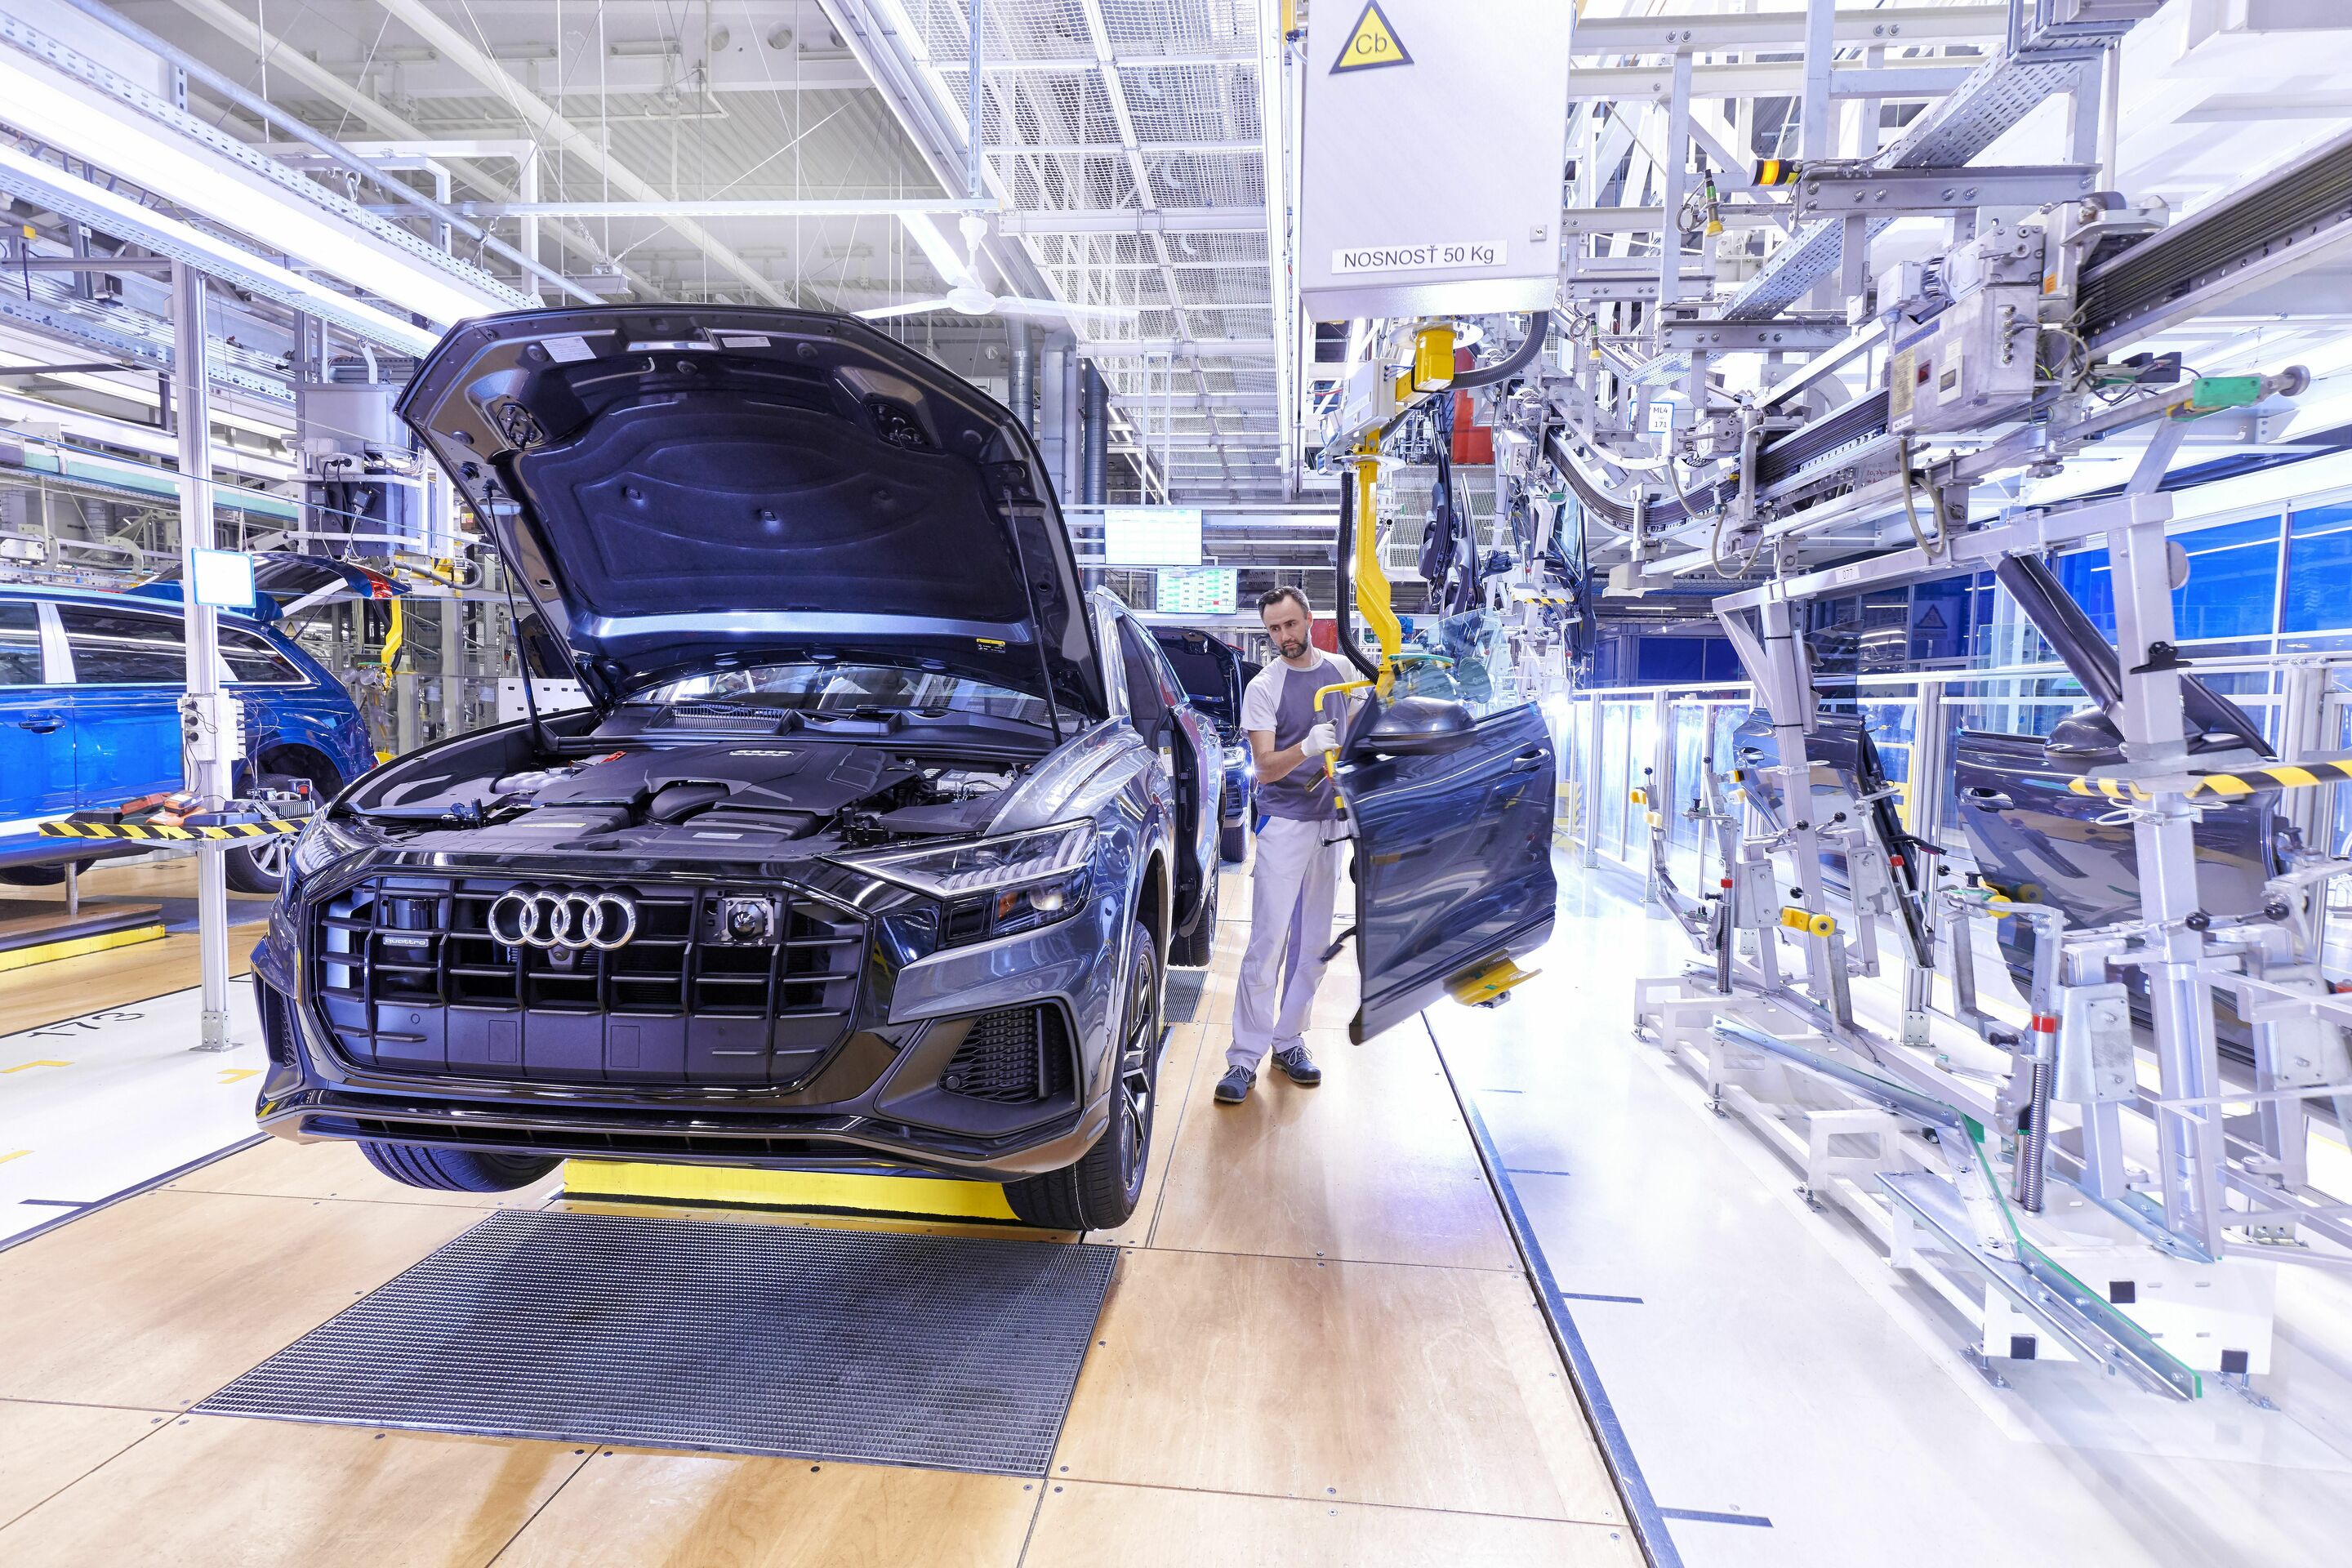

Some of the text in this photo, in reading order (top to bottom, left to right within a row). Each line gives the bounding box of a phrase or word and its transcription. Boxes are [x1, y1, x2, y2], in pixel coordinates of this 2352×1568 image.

[1355, 32, 1388, 55] Cb
[1343, 244, 1494, 269] NOSNOSŤ 50 Kg
[385, 938, 425, 946] quattro
[27, 1013, 145, 1038] 173
